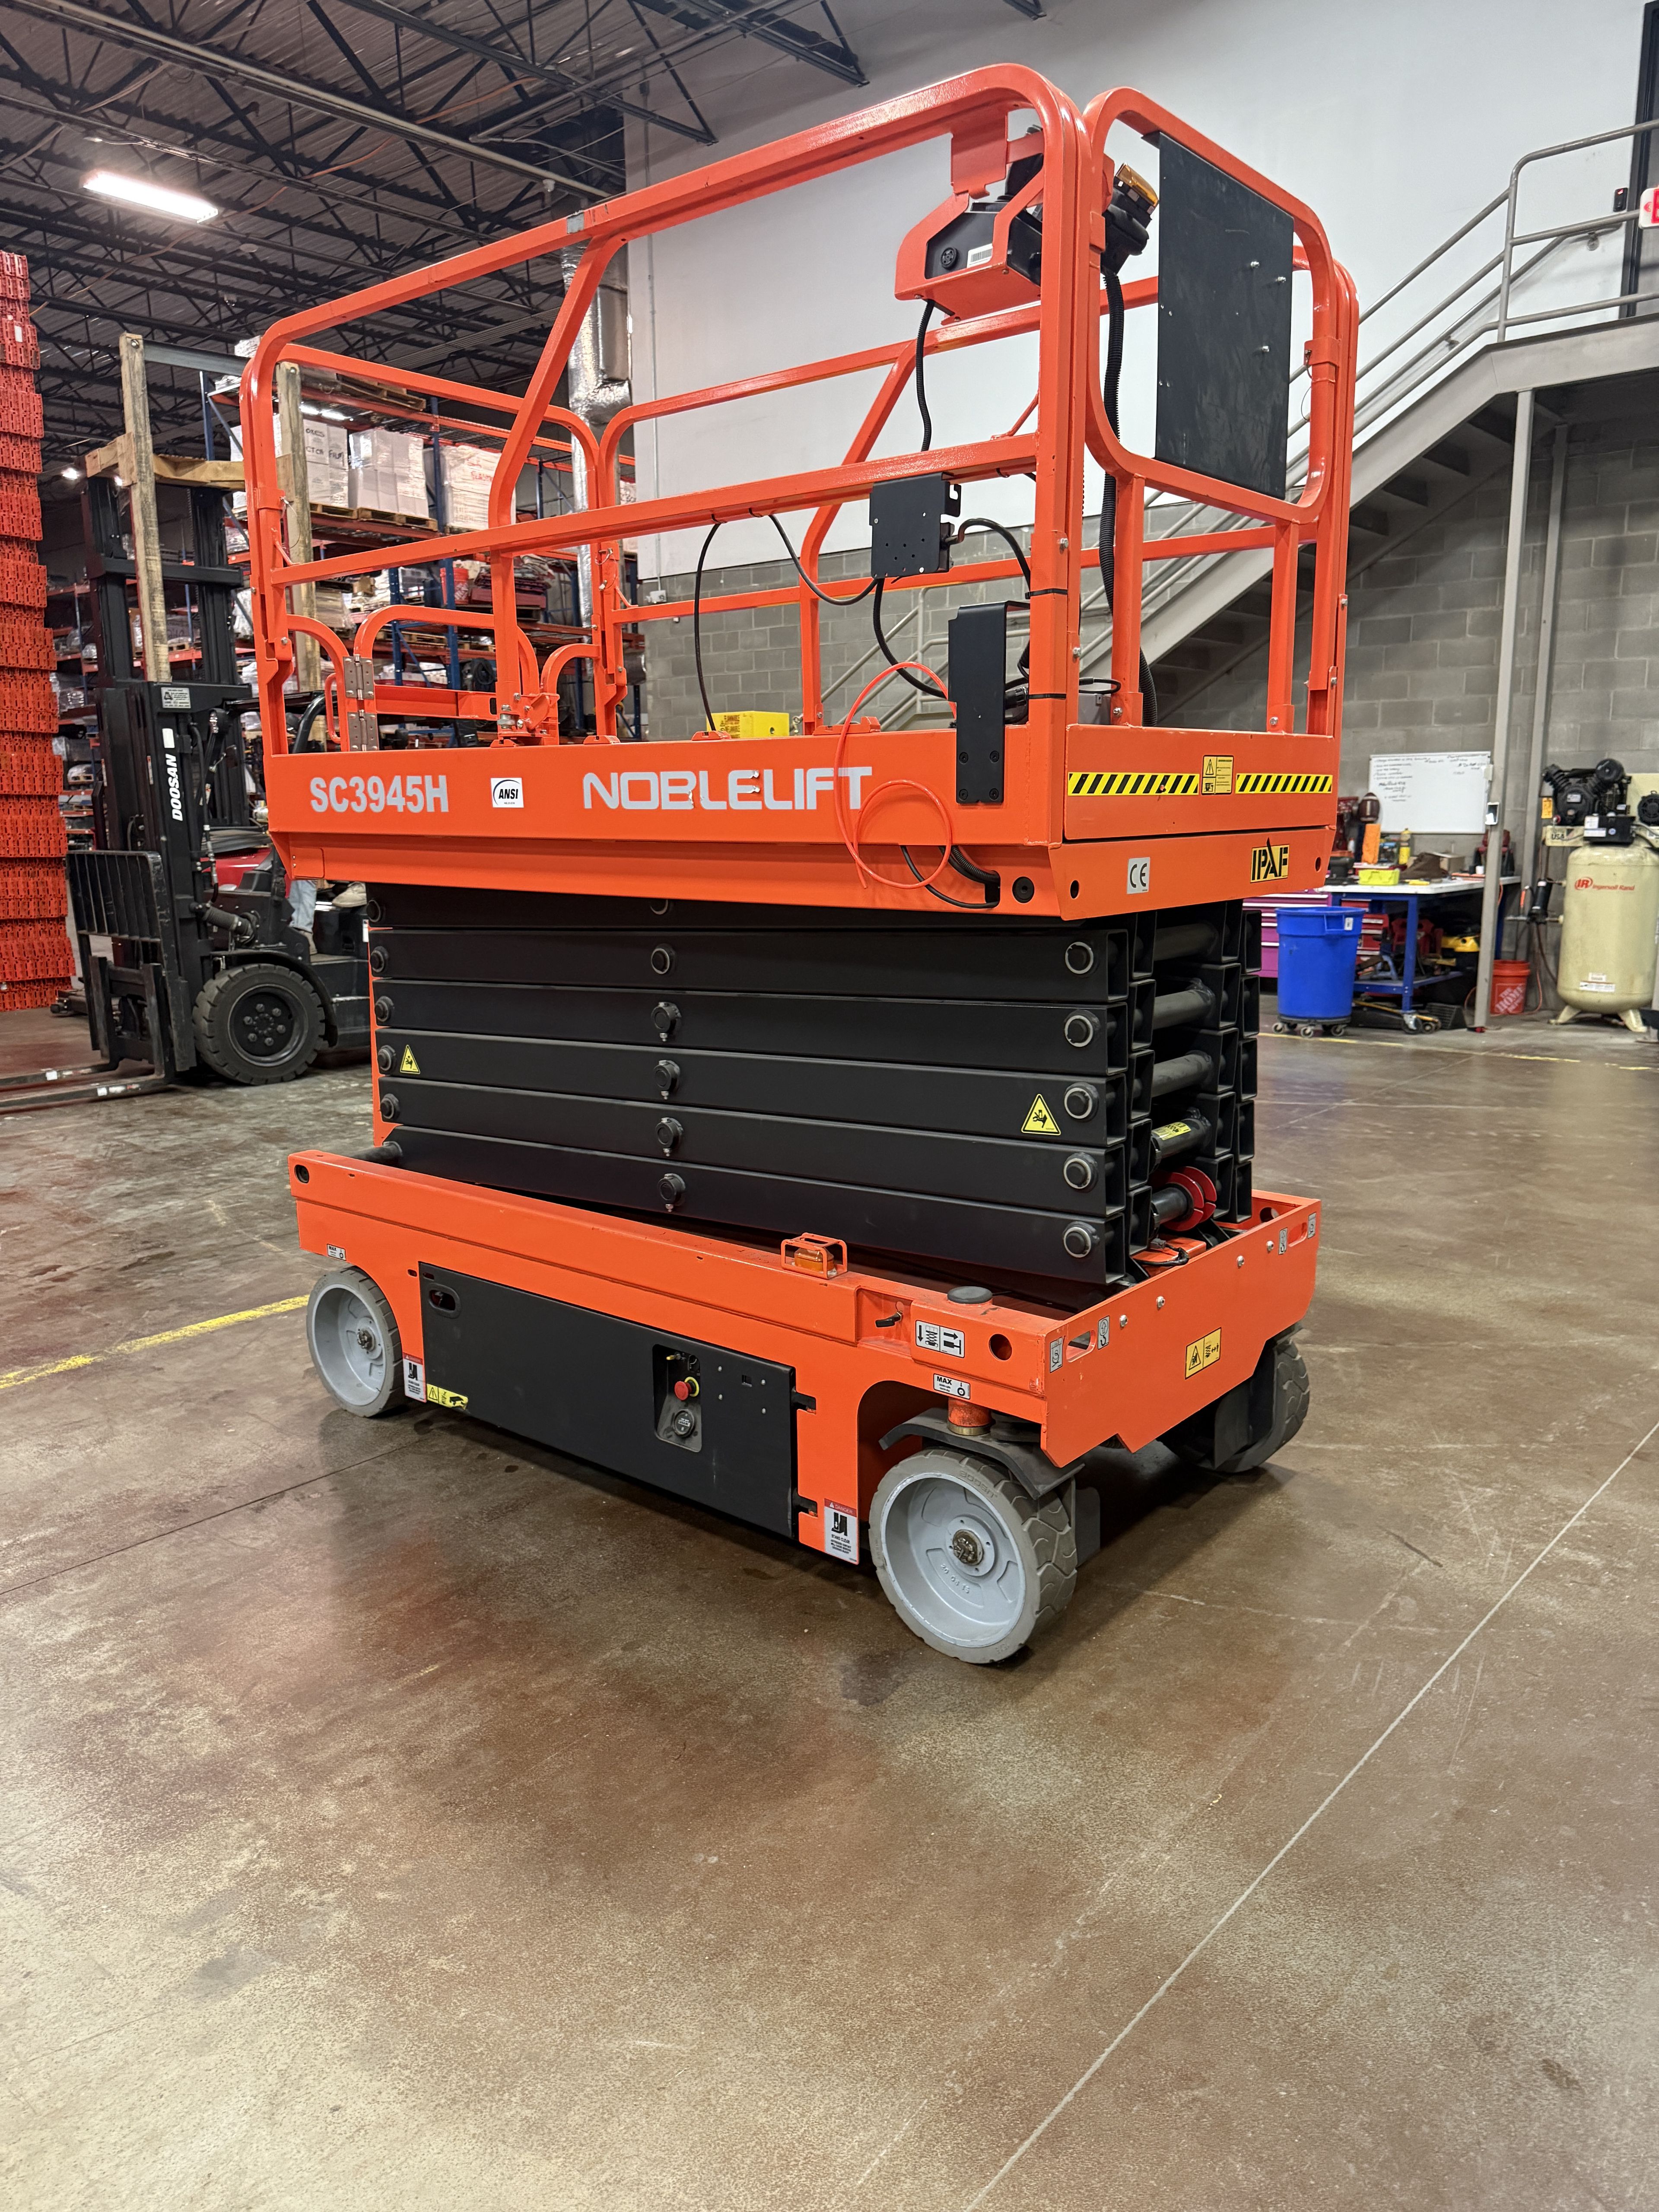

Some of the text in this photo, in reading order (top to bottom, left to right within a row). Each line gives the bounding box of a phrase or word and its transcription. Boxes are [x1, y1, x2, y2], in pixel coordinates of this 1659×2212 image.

[165, 753, 183, 821] DOOSAN
[310, 775, 449, 813] SC3945H
[498, 788, 518, 800] ANSI
[583, 766, 873, 810] NOBLELIFT
[1251, 837, 1288, 880] IPAF
[937, 1376, 952, 1385] MAX
